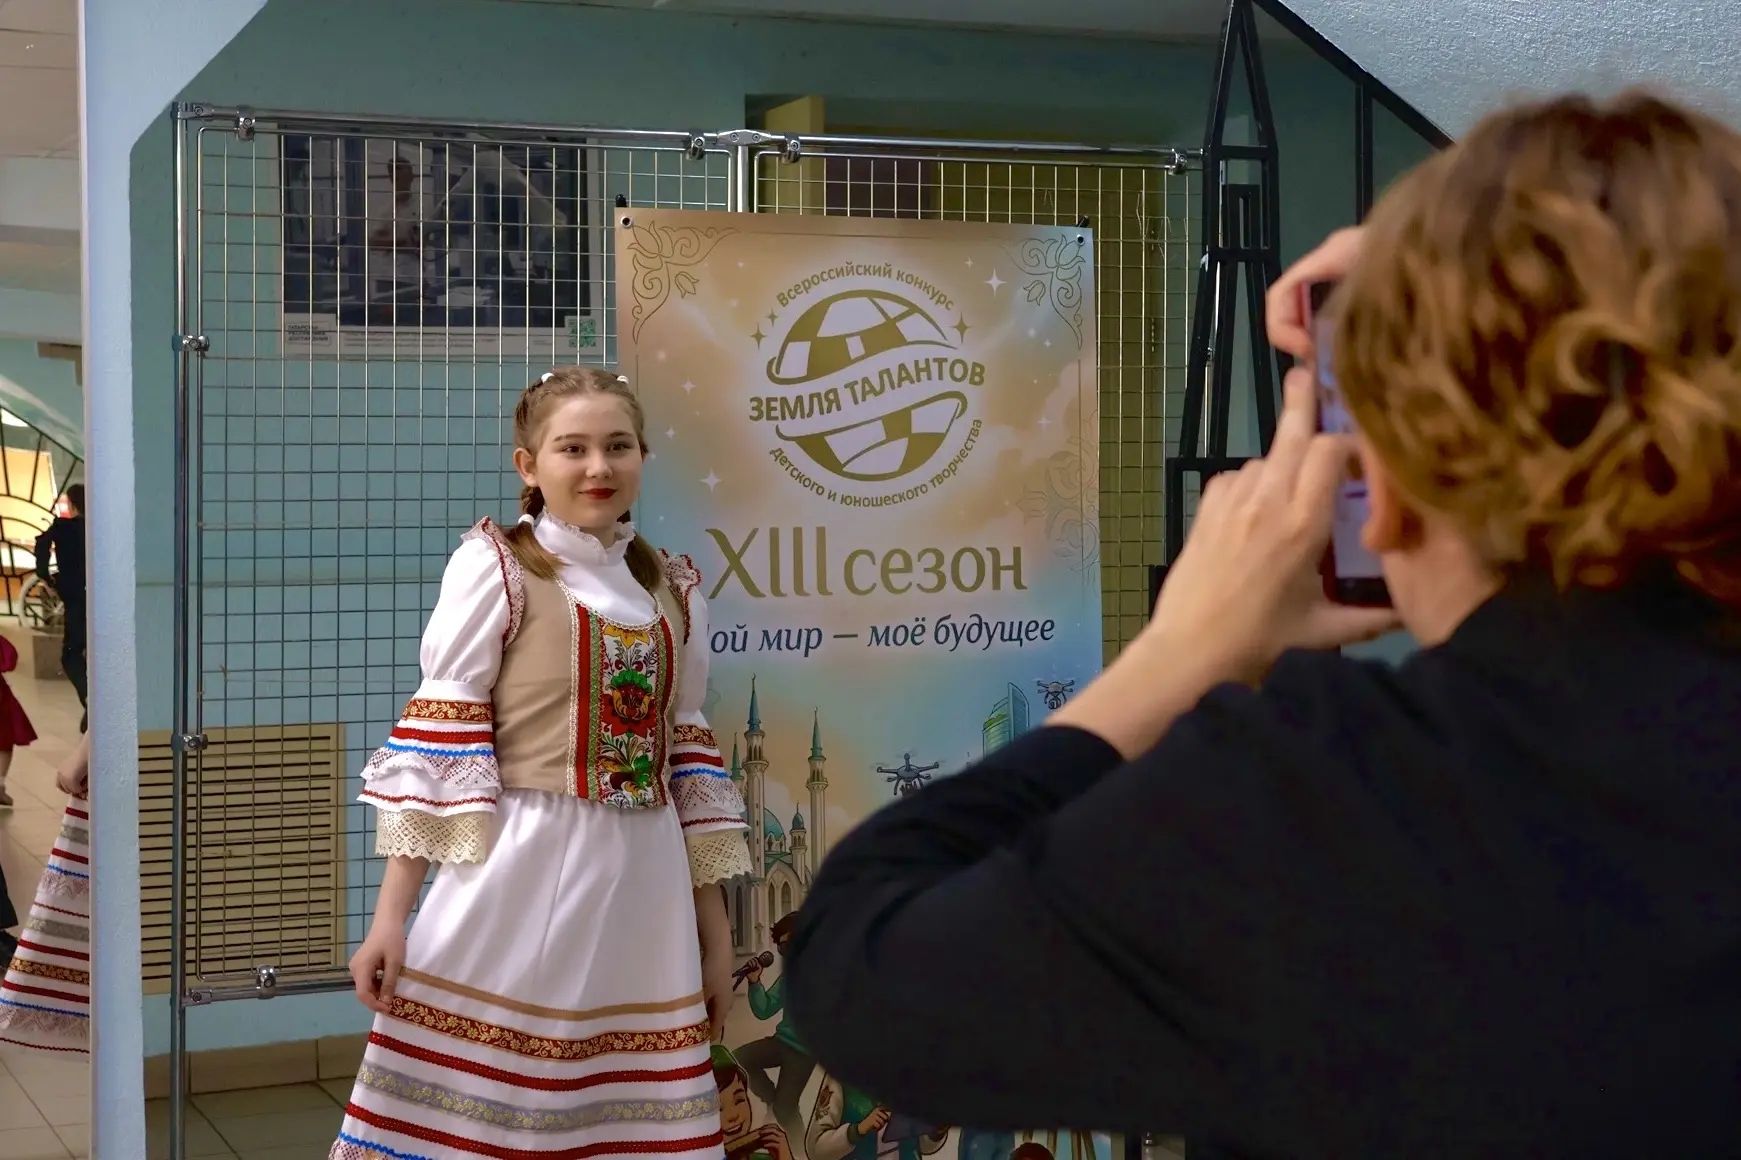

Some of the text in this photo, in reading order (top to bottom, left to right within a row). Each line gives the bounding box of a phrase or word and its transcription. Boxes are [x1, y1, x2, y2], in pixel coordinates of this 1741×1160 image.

[776, 261, 955, 311] Всероссийский конкурс
[748, 357, 986, 422] ЗЕМЛЯ ТАЛАНТОВ
[827, 491, 837, 502] и
[840, 484, 929, 508] юношеского
[929, 418, 983, 489] творчества
[843, 546, 1028, 596] сезон
[706, 623, 749, 654] ой
[758, 626, 823, 657] мир
[867, 616, 926, 647] моё
[933, 613, 1055, 652] будущее
